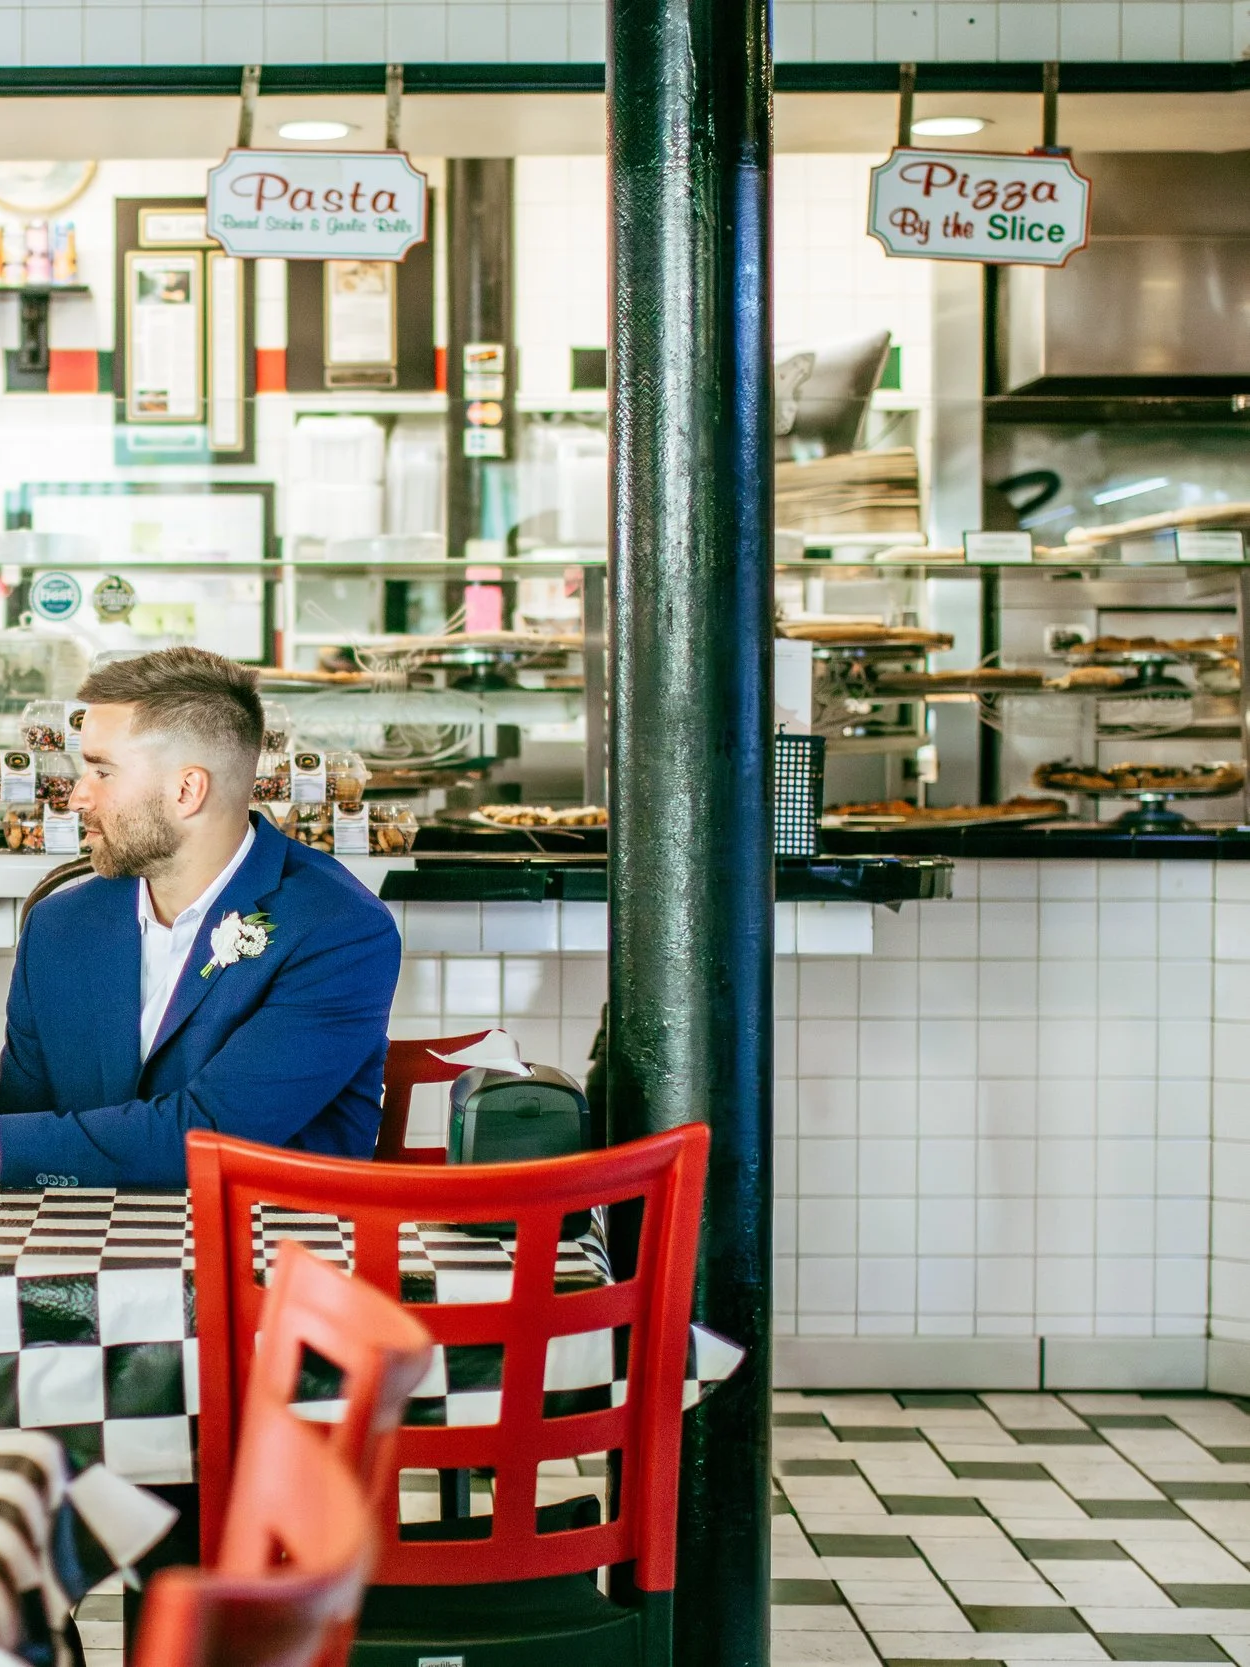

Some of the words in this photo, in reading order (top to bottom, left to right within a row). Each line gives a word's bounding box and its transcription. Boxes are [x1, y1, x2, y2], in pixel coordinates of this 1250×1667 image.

[229, 172, 399, 213] Pasta
[899, 161, 1058, 211] Pizza
[889, 206, 930, 245] By
[942, 211, 974, 239] the
[987, 213, 1065, 243] Slice
